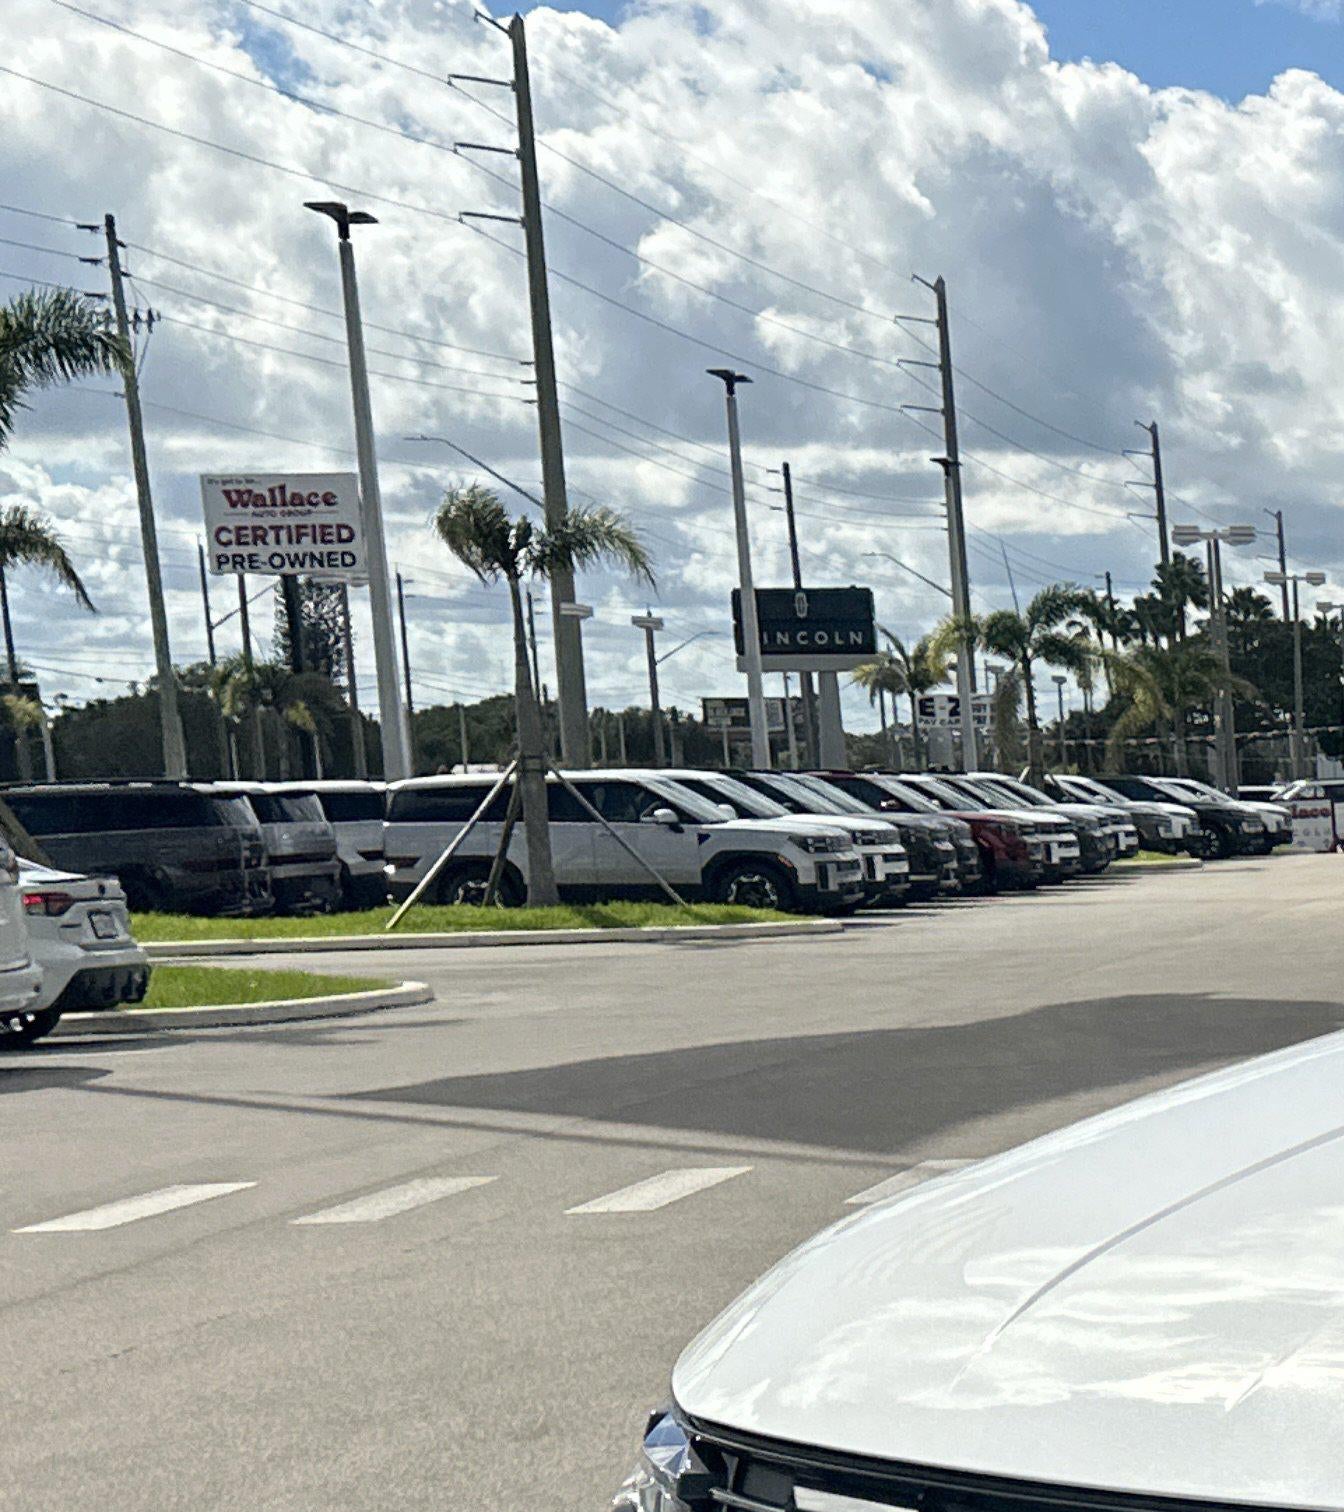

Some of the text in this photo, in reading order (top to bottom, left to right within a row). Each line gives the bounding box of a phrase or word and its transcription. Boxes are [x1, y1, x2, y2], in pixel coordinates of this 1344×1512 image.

[222, 482, 338, 509] Wallace
[214, 523, 355, 547] CERTIFIED
[215, 550, 356, 571] PRE-OWNED
[763, 631, 863, 645] INCOLN
[1292, 804, 1332, 819] lace
